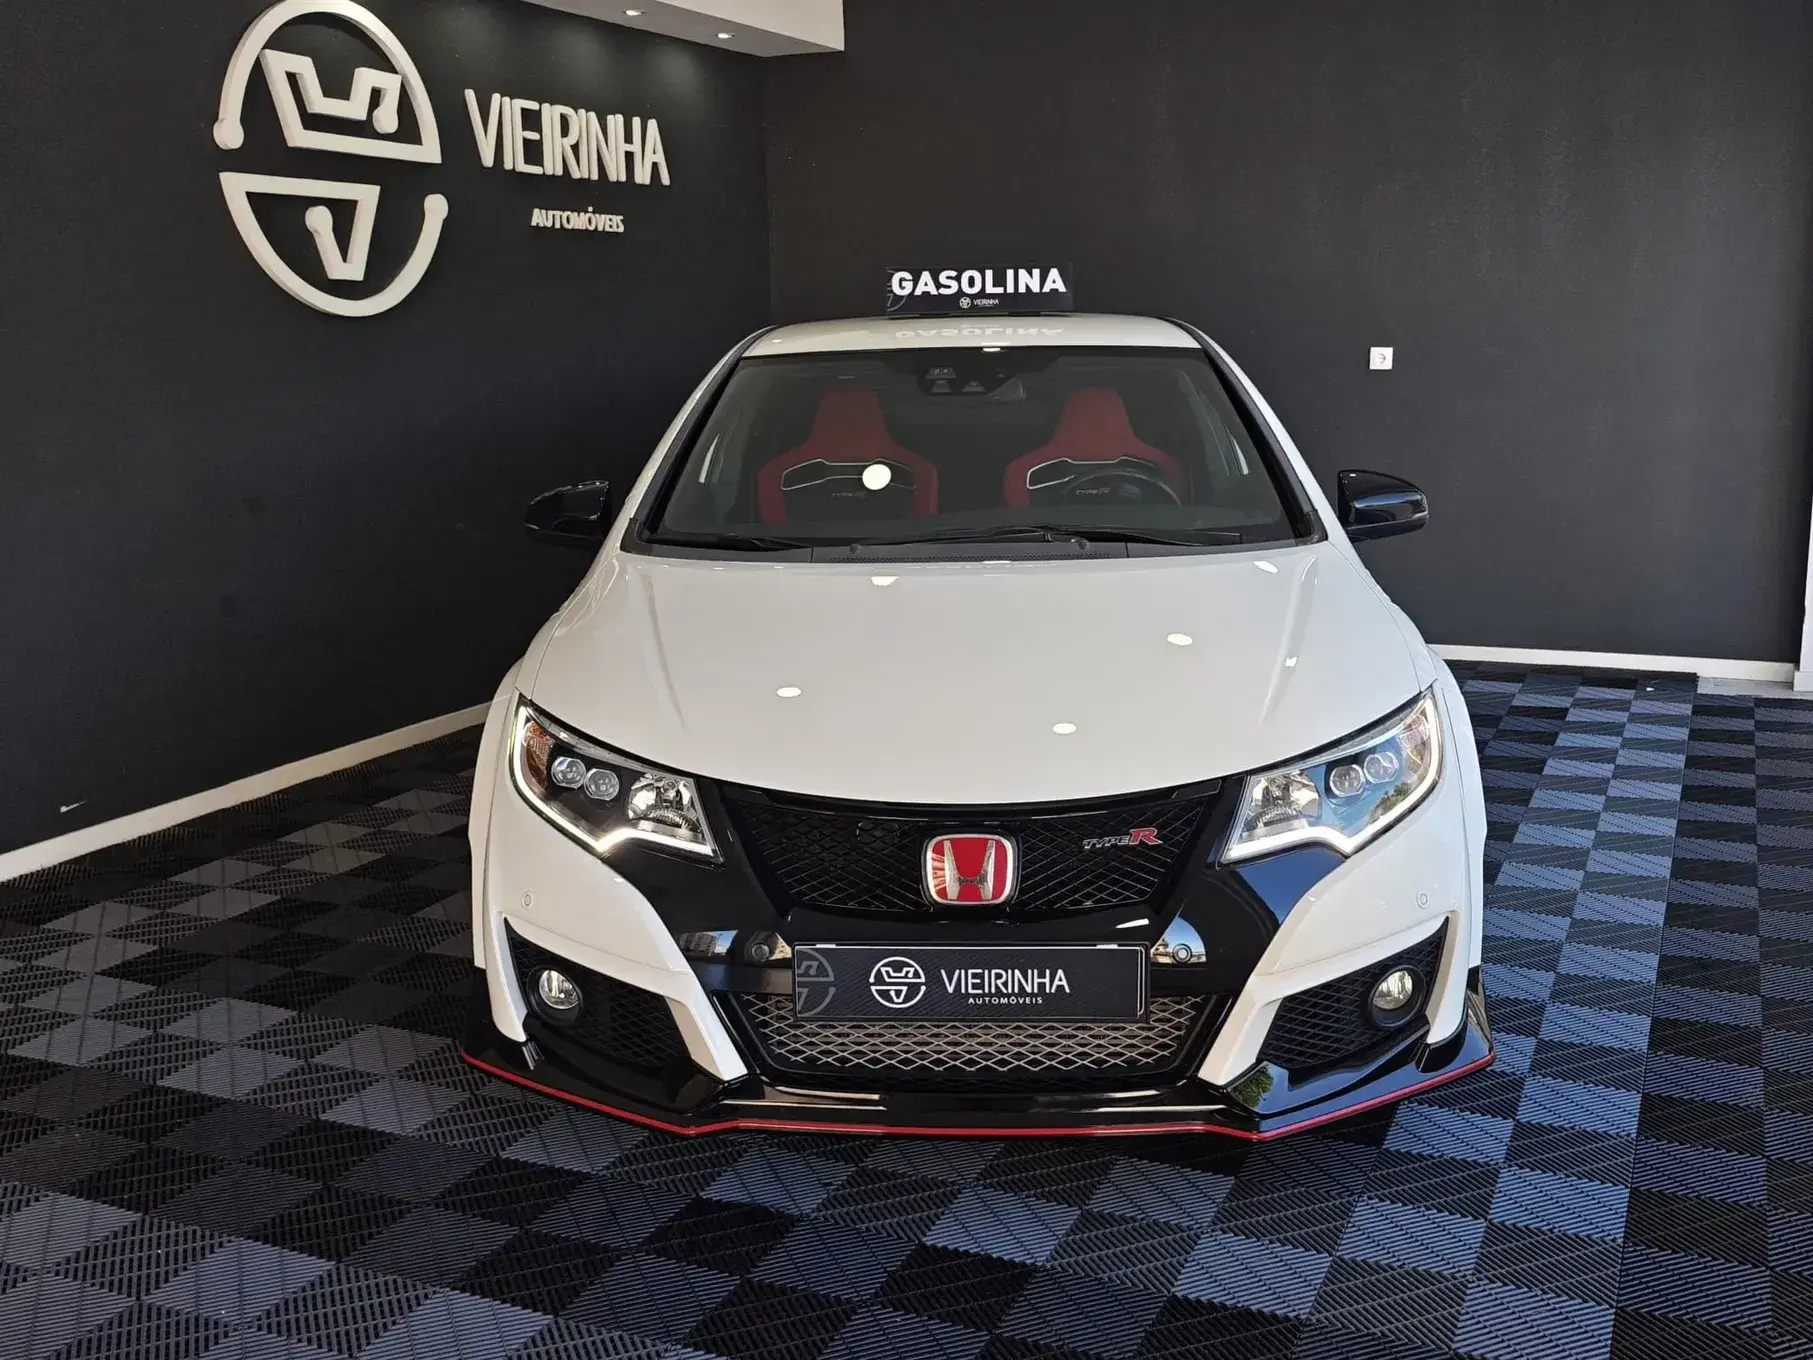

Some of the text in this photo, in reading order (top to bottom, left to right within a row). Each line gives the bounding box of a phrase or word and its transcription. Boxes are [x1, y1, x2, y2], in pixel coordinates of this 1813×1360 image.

[464, 88, 671, 186] VIEIRINHA
[530, 206, 625, 233] AUTOMÓVEIS
[891, 267, 1067, 296] GASOLINA
[940, 968, 1070, 994] VIEIRINHA
[967, 995, 1044, 1005] AUTOMÓVEIS
